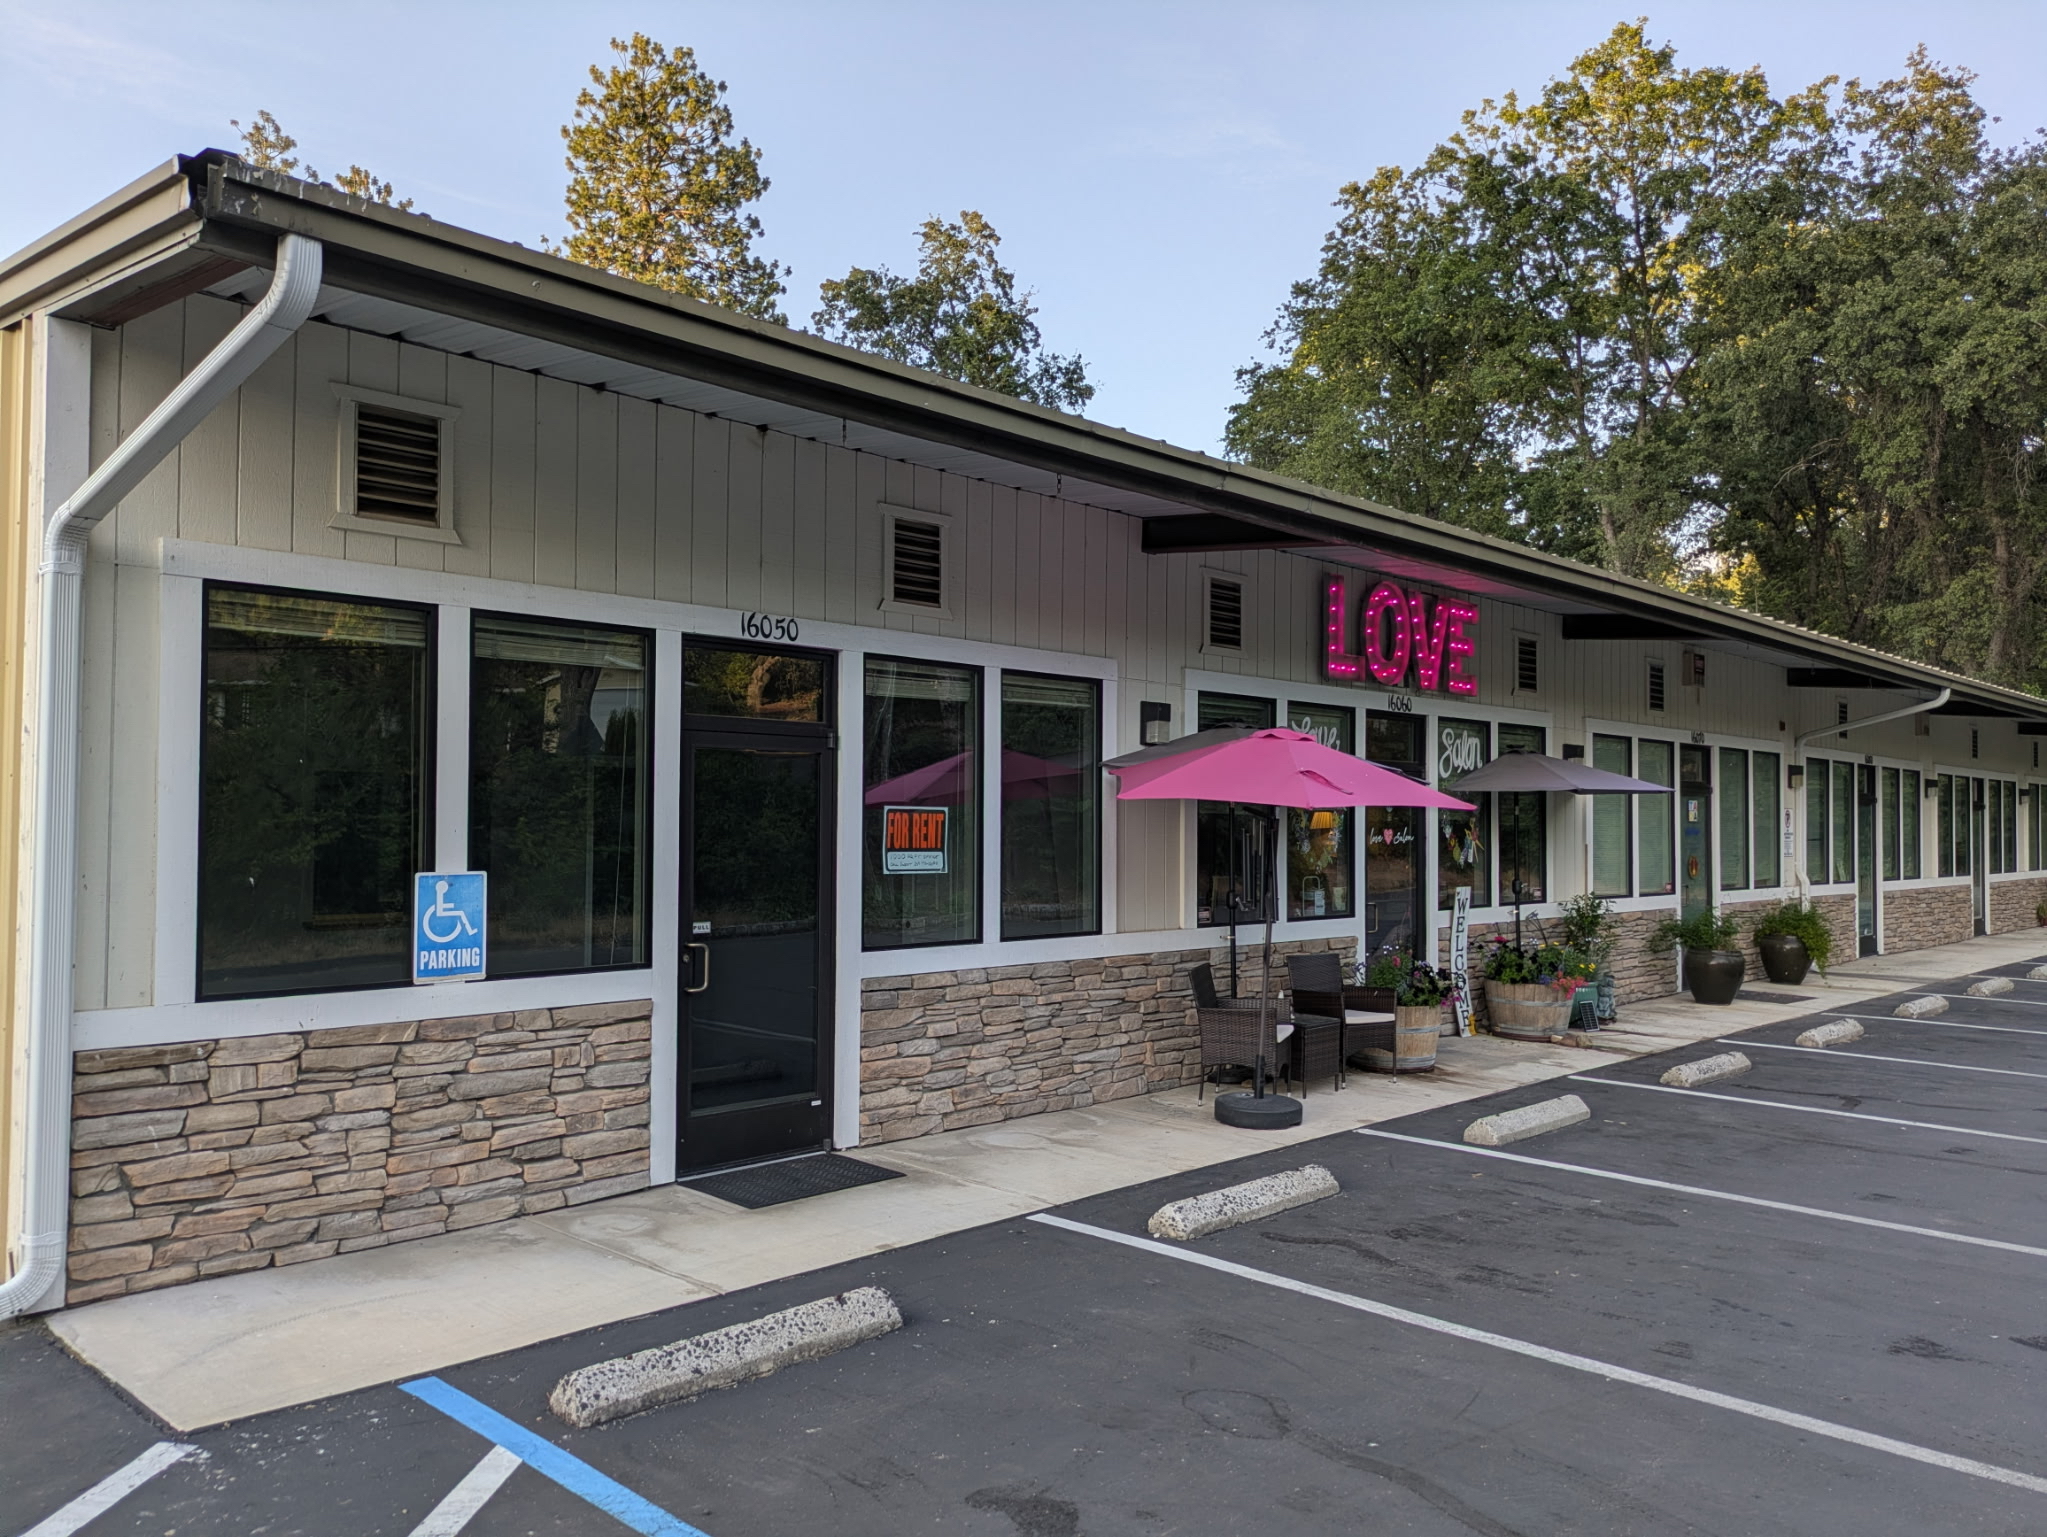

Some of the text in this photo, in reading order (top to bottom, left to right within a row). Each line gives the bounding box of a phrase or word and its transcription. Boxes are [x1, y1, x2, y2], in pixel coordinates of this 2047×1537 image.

[741, 611, 799, 642] 16050
[1327, 573, 1479, 697] LOVE
[1387, 694, 1412, 712] 16060
[1291, 716, 1341, 751] ve
[1439, 728, 1483, 779] Salon
[887, 811, 945, 849] FOR RENT
[420, 947, 480, 970] PARKING
[1455, 897, 1471, 1028] WELCOME
